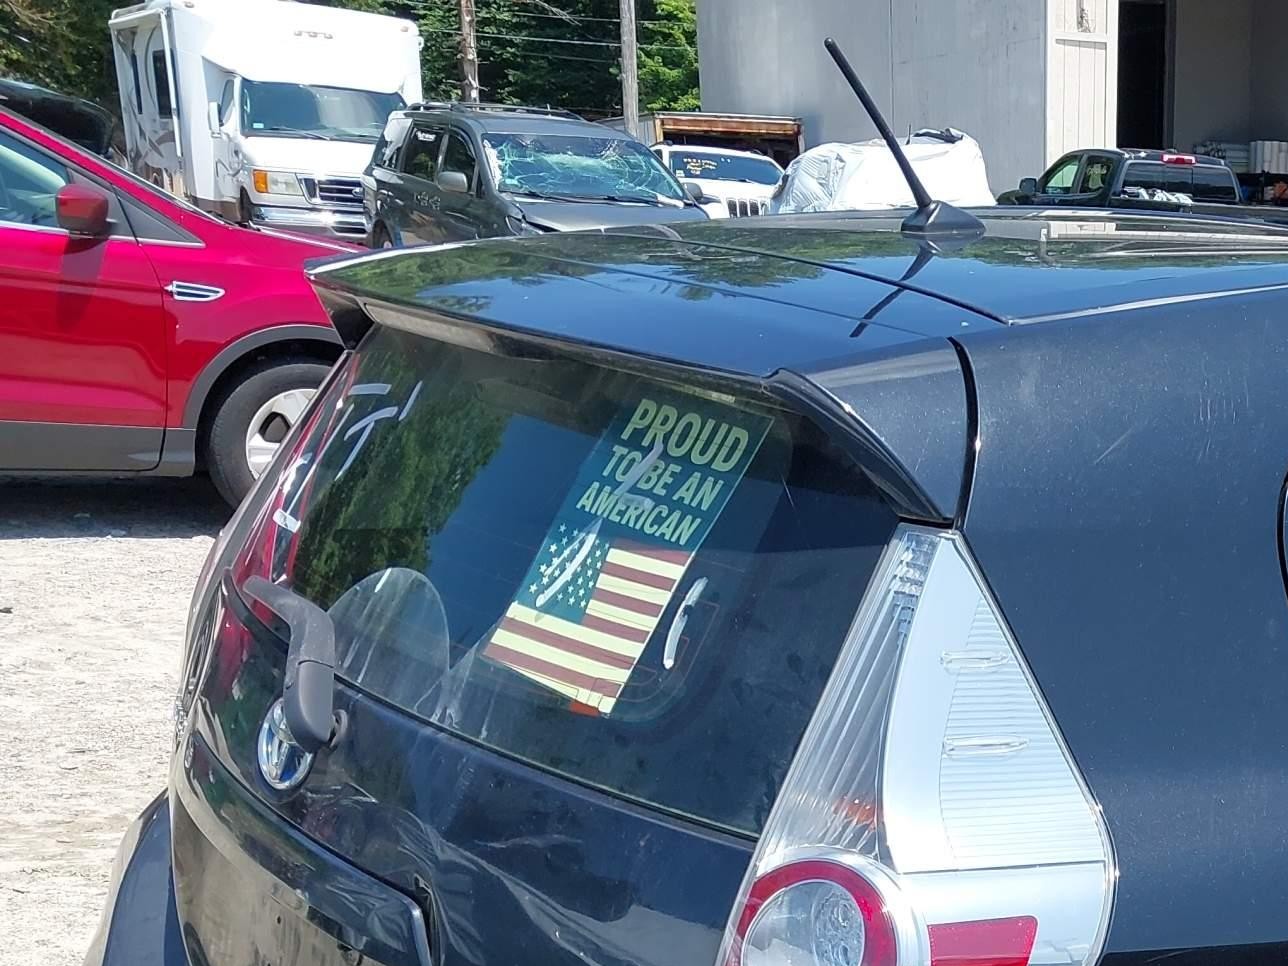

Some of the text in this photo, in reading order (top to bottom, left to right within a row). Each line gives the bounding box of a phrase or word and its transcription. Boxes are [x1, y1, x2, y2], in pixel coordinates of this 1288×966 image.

[620, 398, 749, 472] PROUD
[602, 444, 724, 511] TO BE AN
[575, 481, 702, 546] AMERICAN
